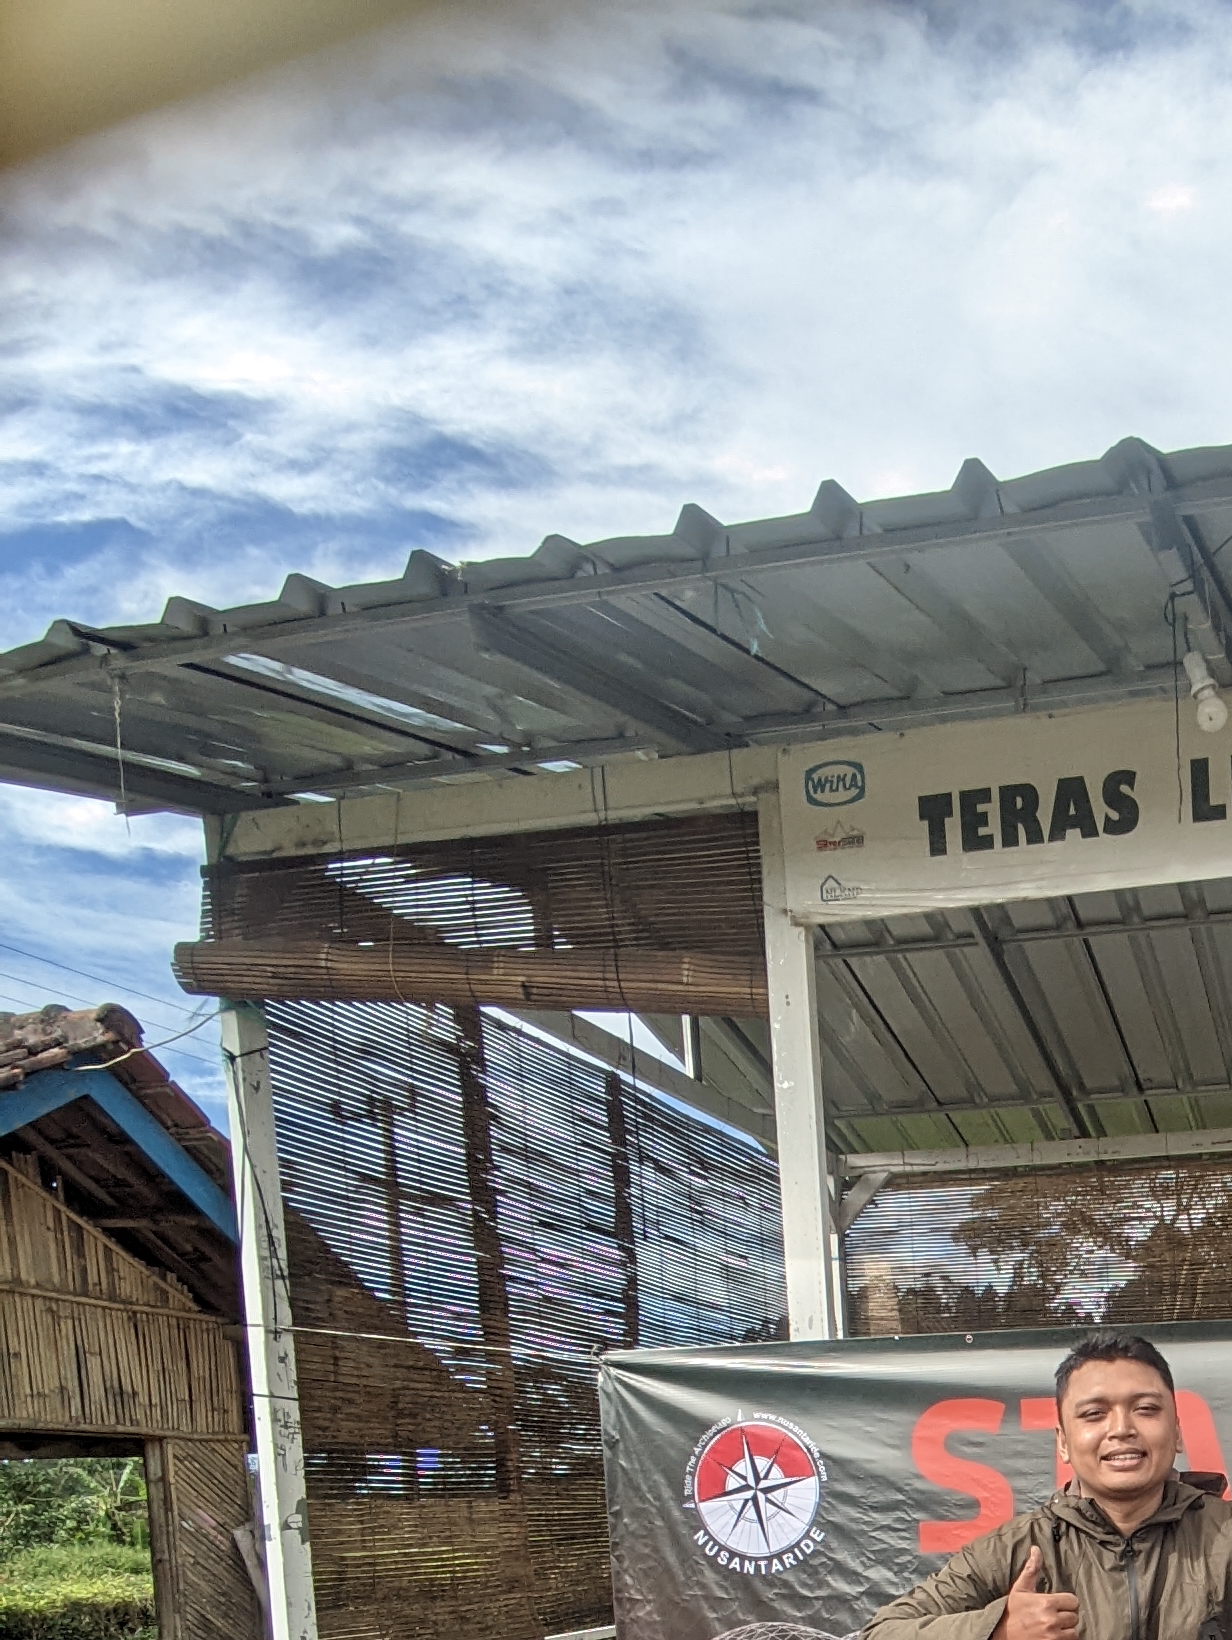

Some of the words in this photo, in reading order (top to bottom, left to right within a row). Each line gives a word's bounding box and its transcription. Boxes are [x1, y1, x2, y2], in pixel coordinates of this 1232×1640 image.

[918, 769, 1140, 857] TERAS
[752, 1411, 828, 1482] www.nusantaride.com
[693, 1526, 826, 1576] NUSANTARIDE
